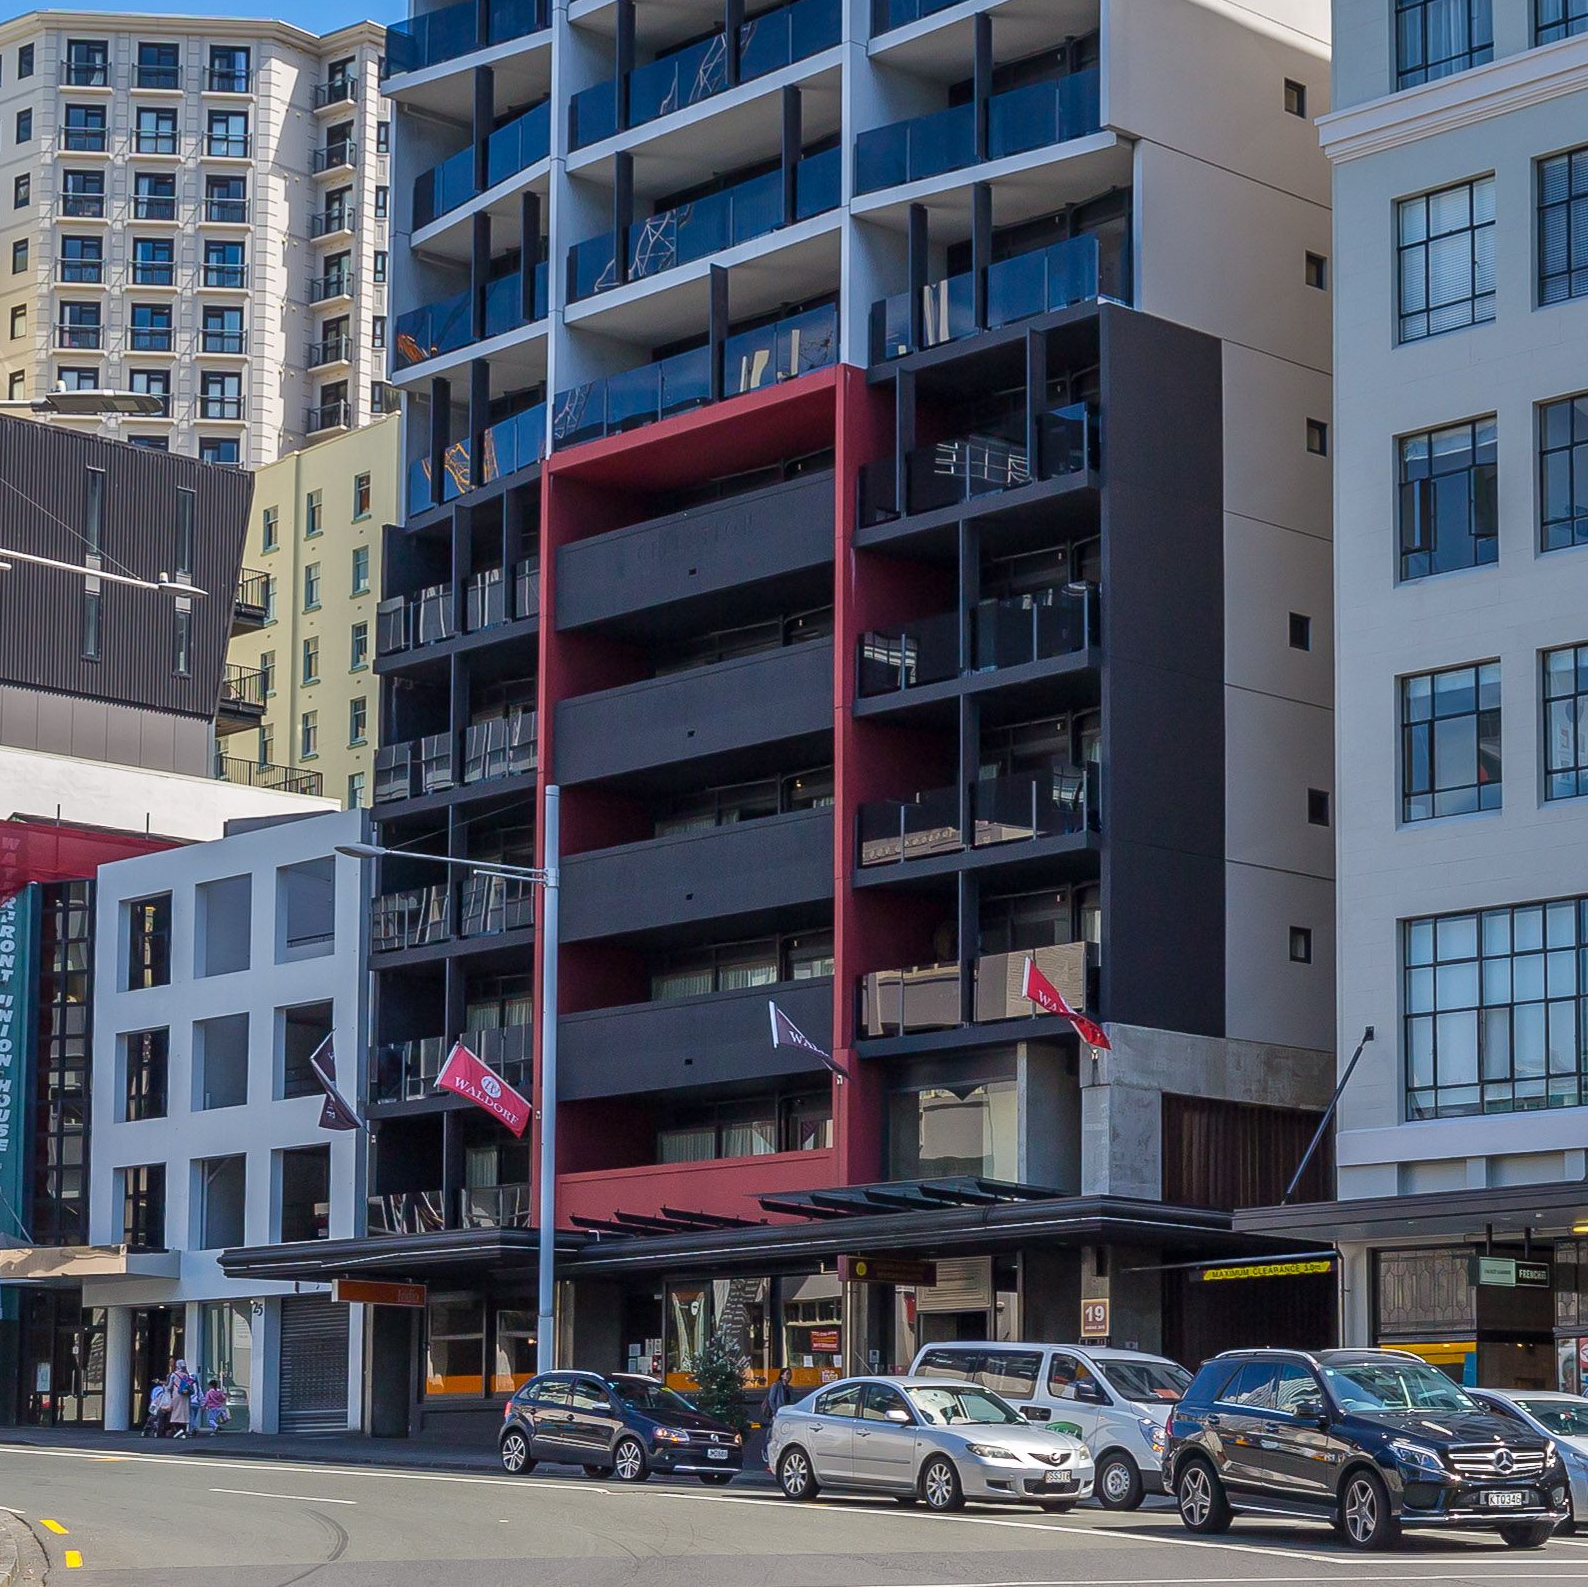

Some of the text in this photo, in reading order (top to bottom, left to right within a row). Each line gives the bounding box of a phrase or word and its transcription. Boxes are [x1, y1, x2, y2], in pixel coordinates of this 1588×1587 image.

[454, 1076, 519, 1126] WALDORF
[1212, 1269, 1249, 1278] MAXIMUM
[1253, 1265, 1300, 1275] CLEARANCE
[253, 1301, 263, 1317] 25
[1085, 1306, 1105, 1322] 19
